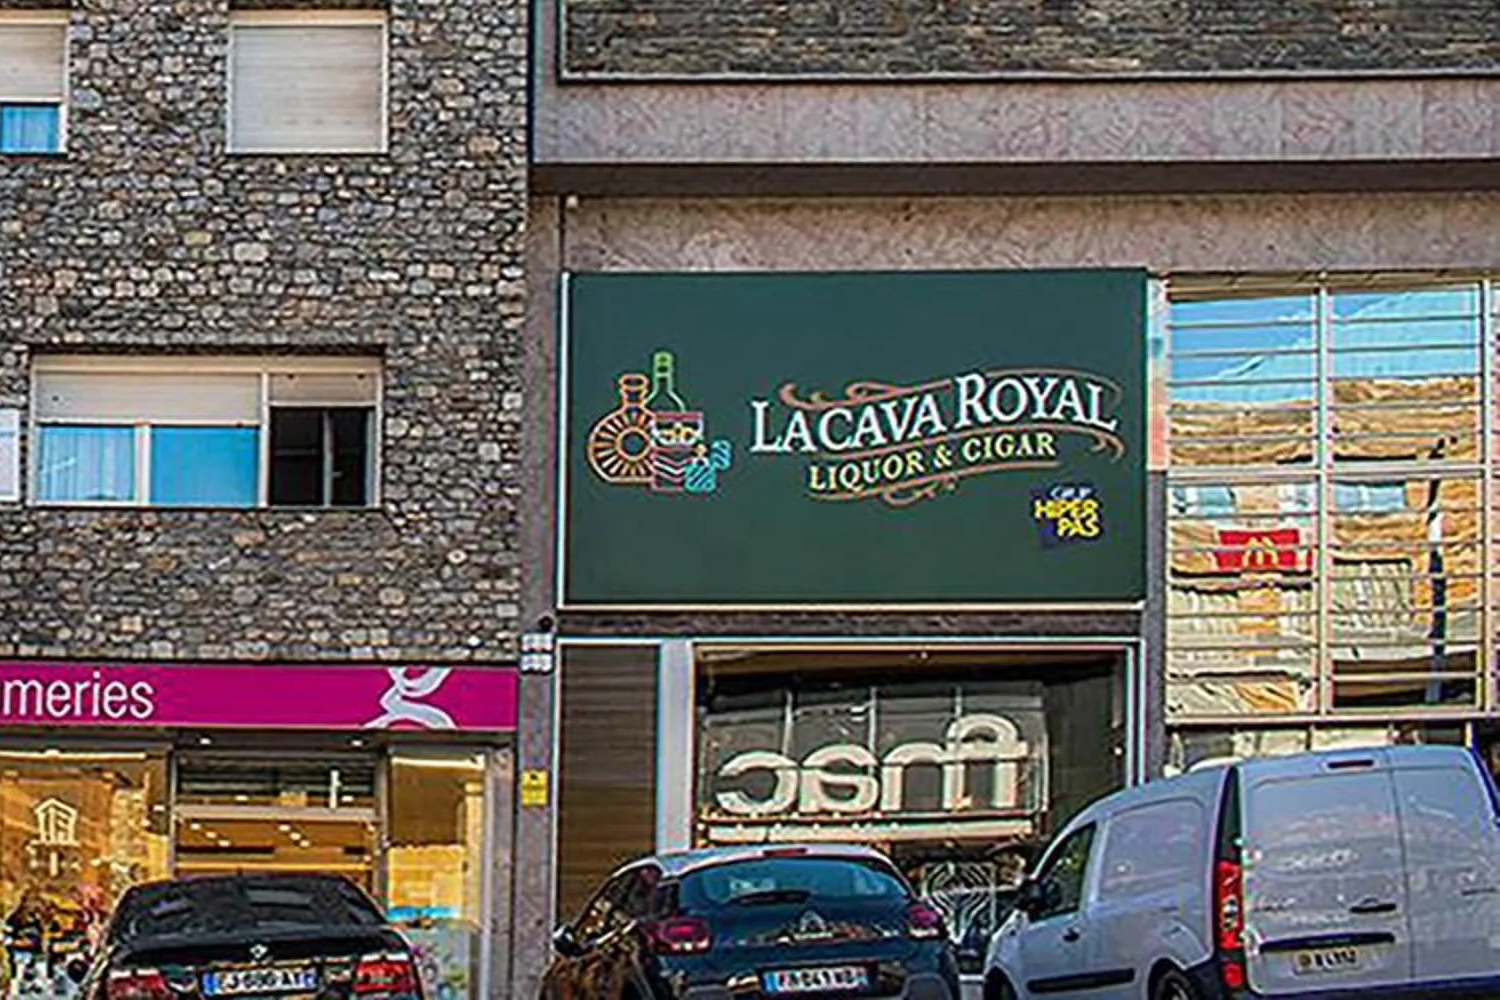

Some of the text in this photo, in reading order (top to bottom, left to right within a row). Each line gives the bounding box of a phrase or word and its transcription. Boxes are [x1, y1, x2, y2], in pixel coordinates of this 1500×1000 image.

[954, 373, 1118, 431] ROYAL
[809, 431, 1056, 492] LIQUOR & CIGAR
